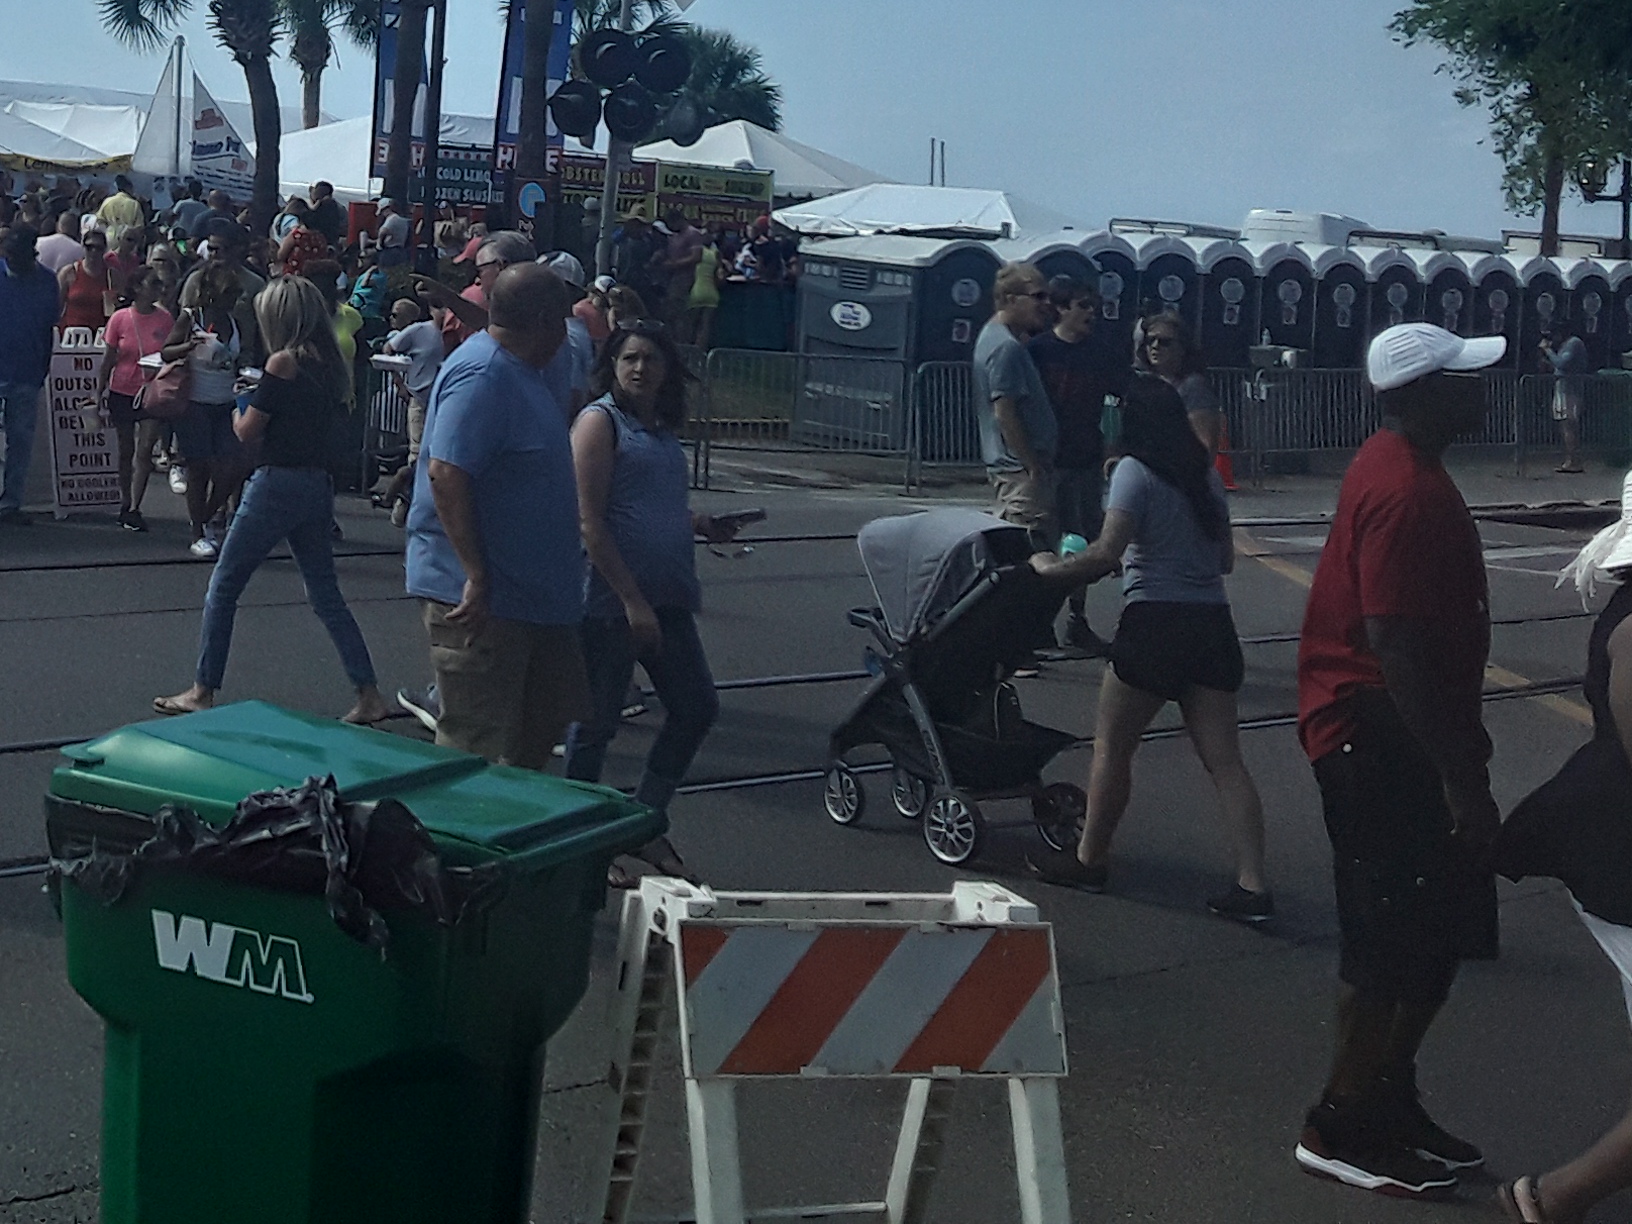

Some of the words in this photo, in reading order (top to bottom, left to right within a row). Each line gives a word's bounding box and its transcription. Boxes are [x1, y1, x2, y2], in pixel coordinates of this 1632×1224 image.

[73, 357, 93, 371] NO
[54, 377, 98, 392] OUTSI
[73, 432, 106, 447] THIS
[69, 452, 112, 468] POINT
[79, 477, 118, 488] COOLER
[151, 908, 311, 1002] WM
